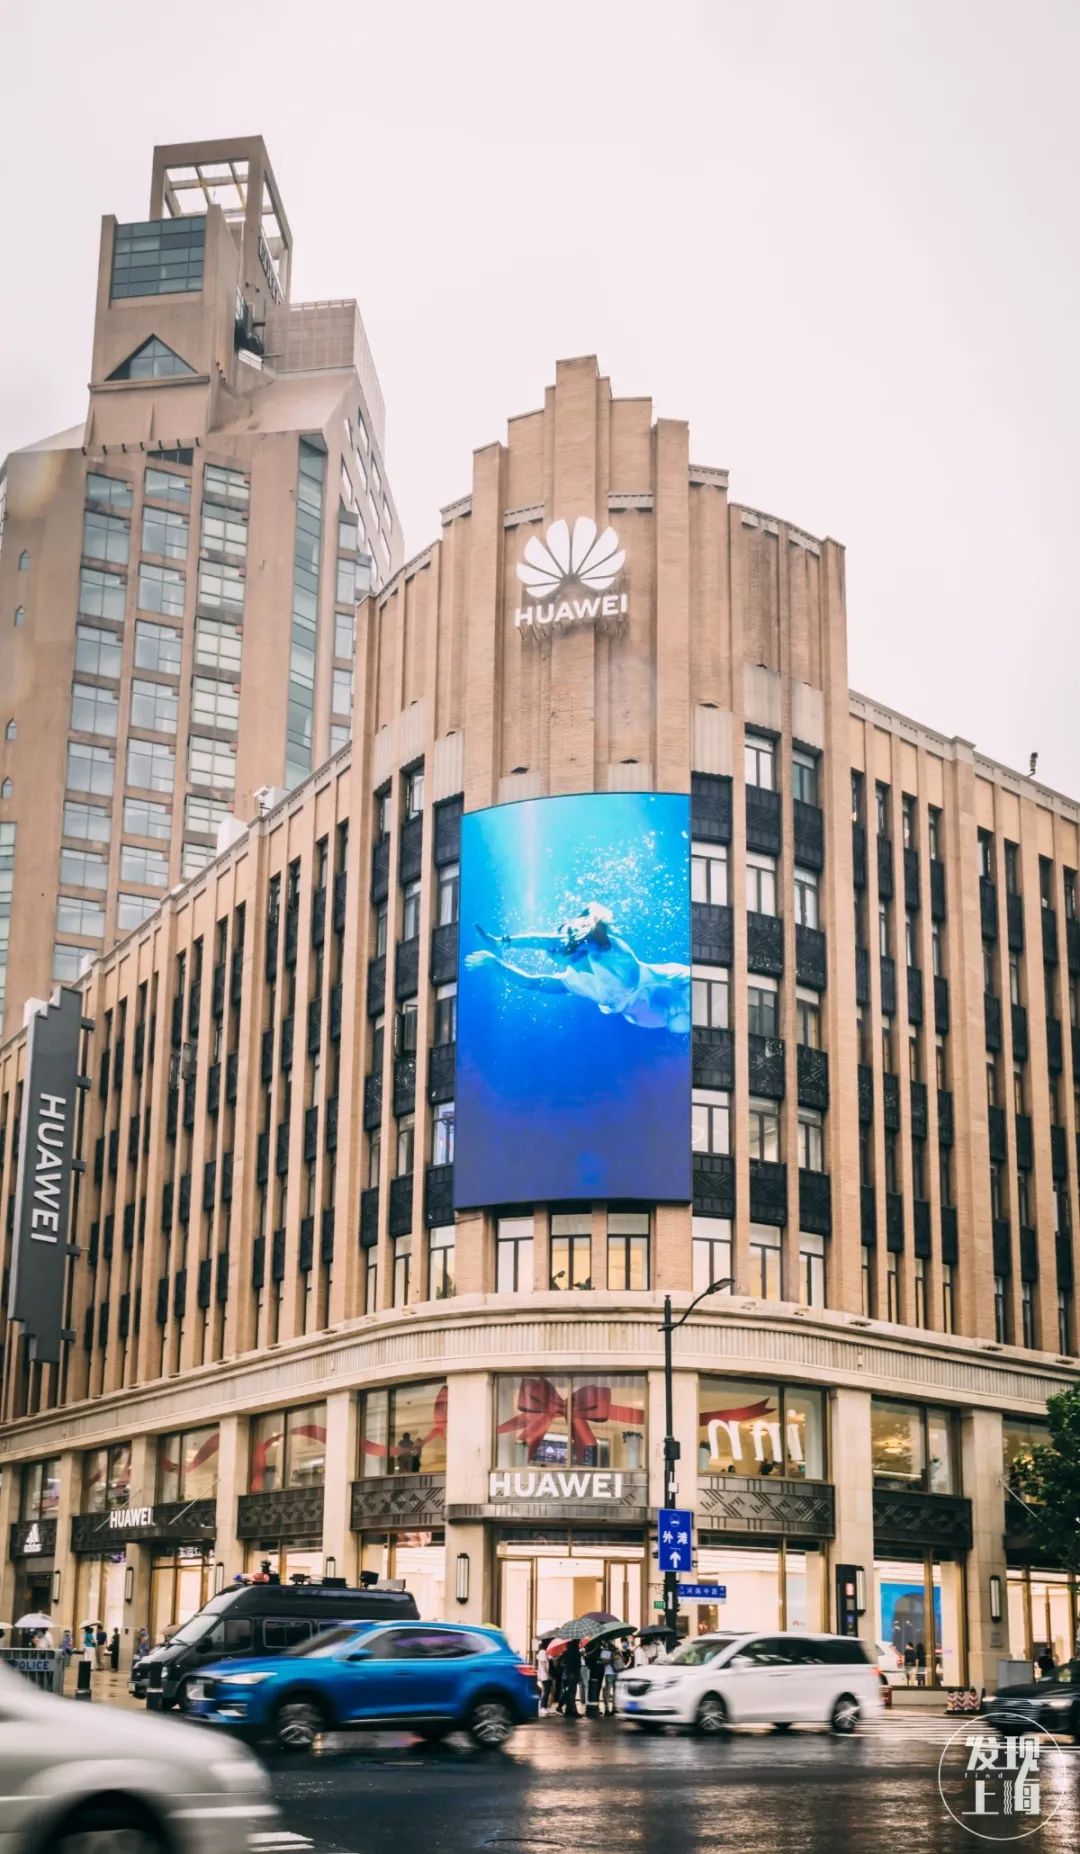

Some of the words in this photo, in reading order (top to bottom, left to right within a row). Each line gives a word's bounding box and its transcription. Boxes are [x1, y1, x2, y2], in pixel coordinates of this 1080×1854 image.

[515, 594, 627, 627] HUAWEI
[30, 1093, 67, 1243] HUAWEI
[489, 1472, 623, 1498] HUAWEI
[110, 1507, 154, 1529] HUAWEI
[662, 1530, 688, 1545] 外滩
